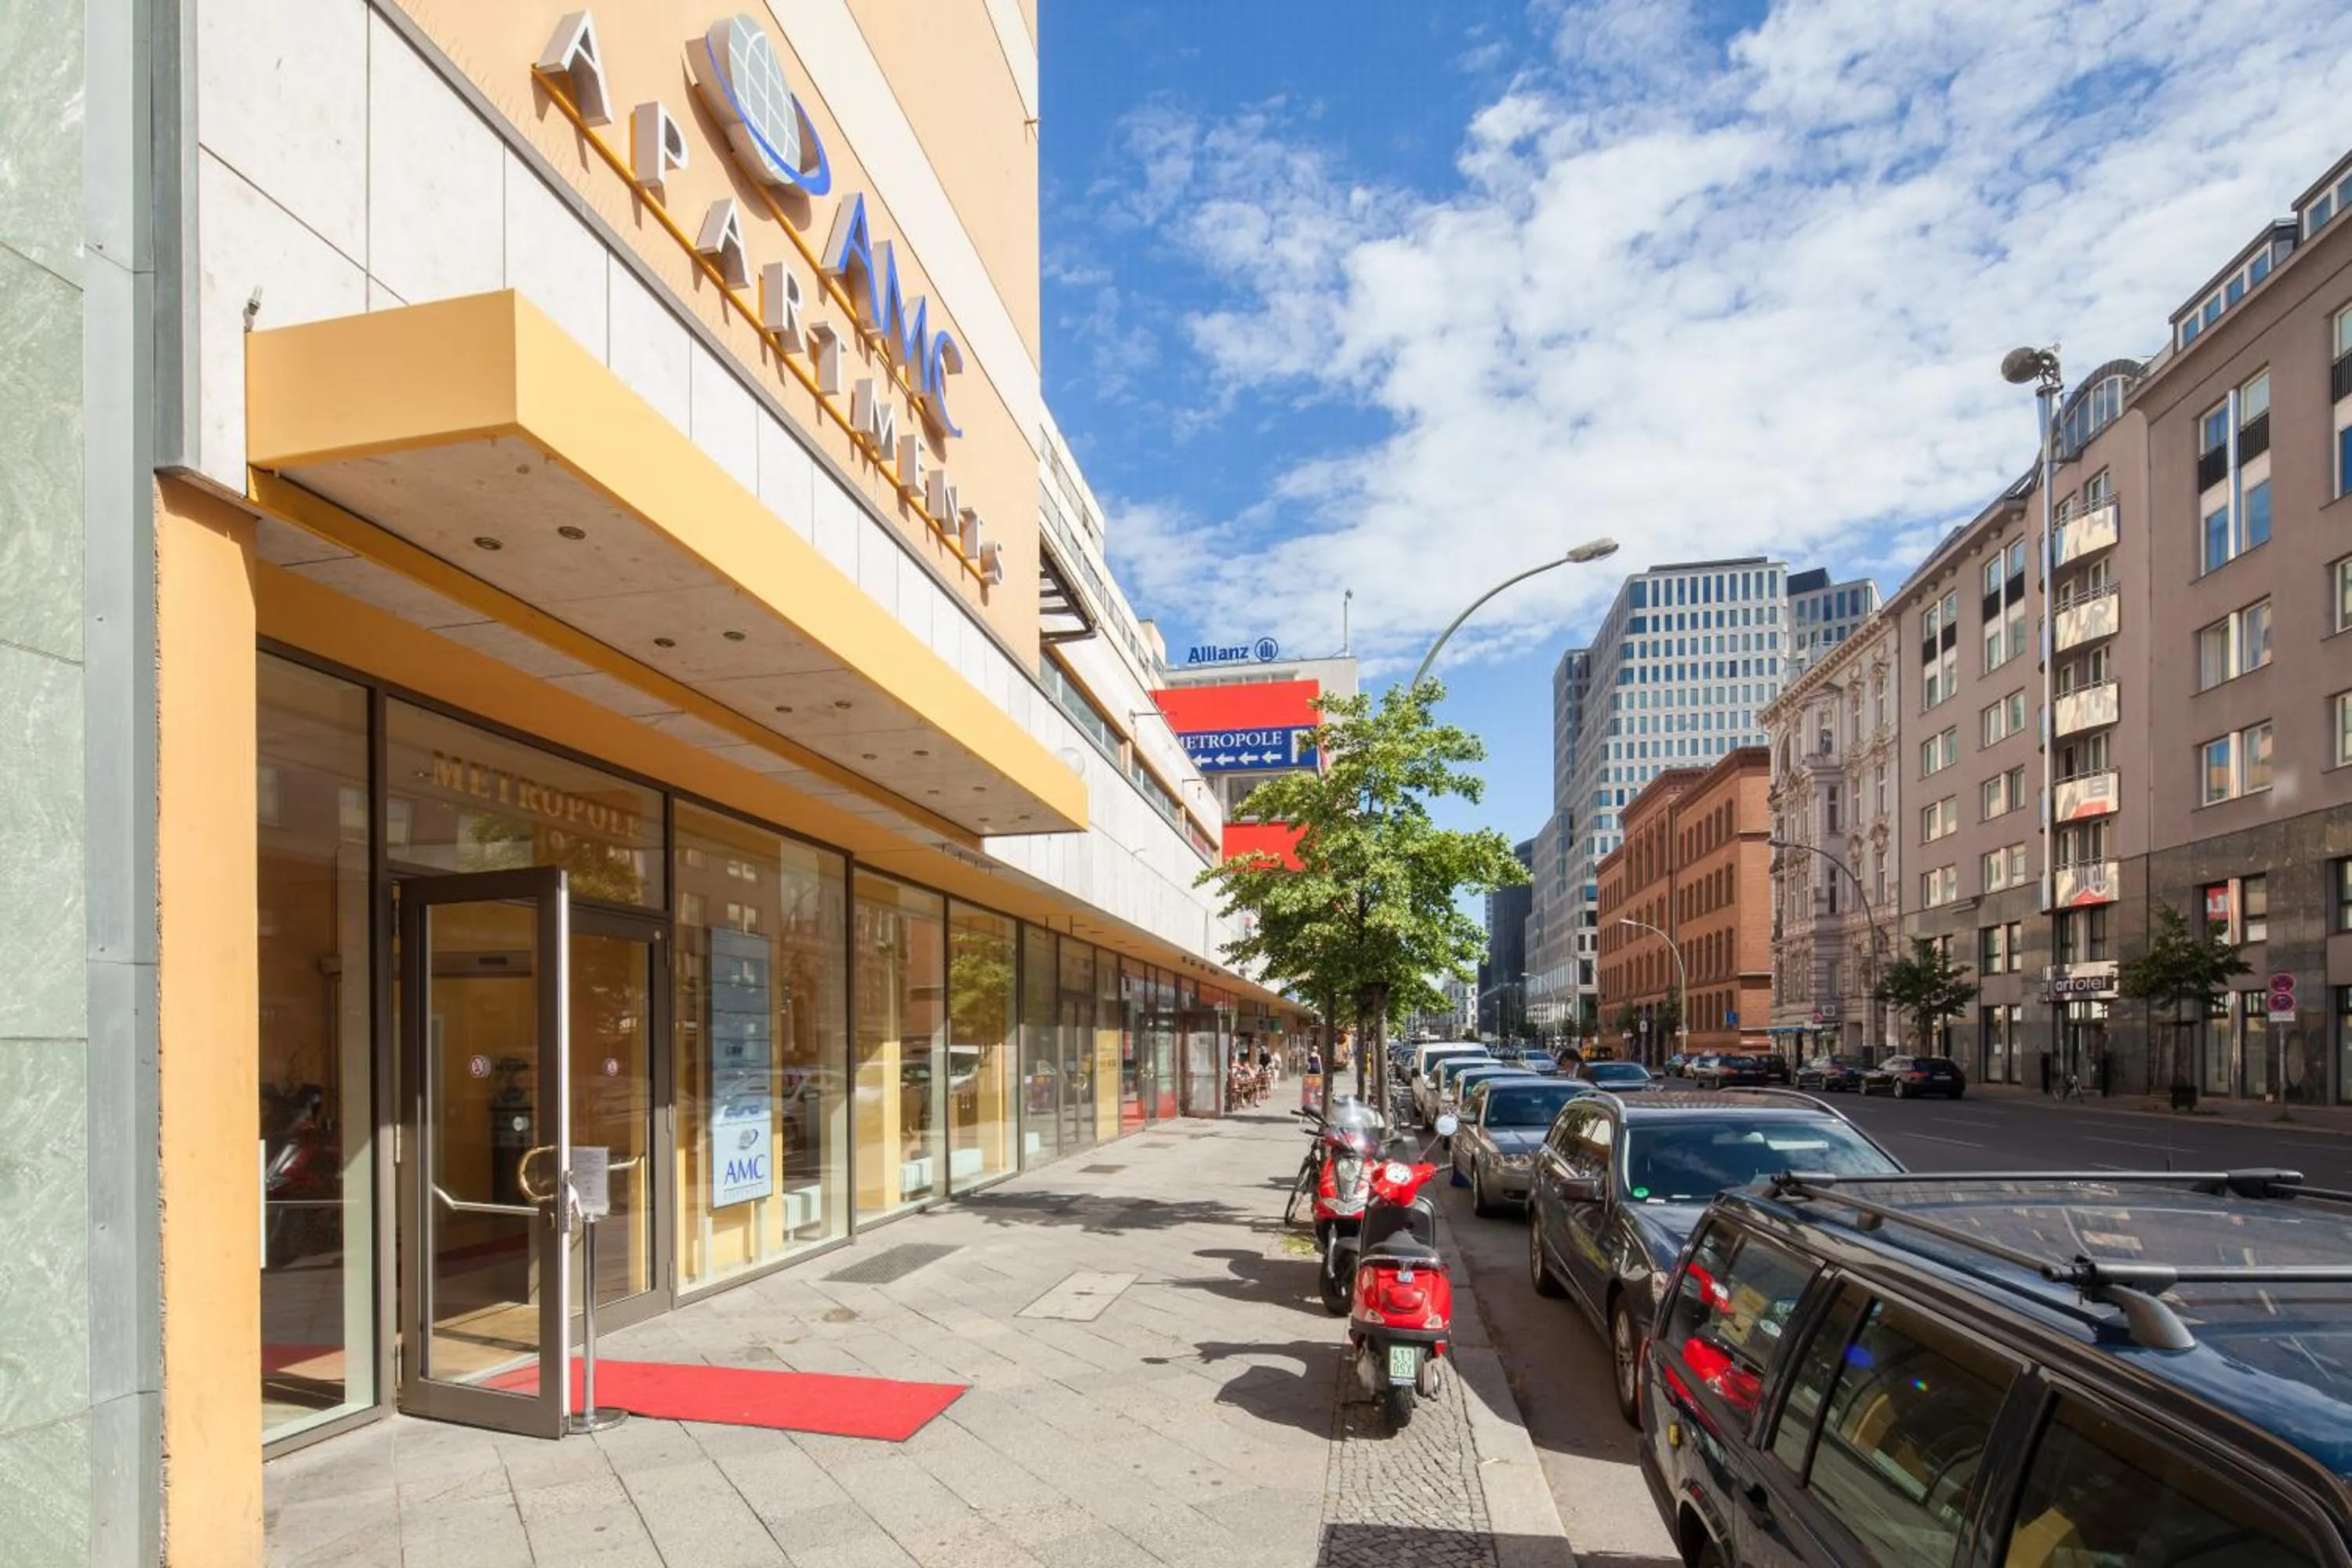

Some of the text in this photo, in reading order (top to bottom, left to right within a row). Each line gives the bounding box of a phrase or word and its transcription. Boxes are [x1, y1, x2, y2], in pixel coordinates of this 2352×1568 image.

[533, 9, 1002, 586] APARTMENTS
[822, 191, 964, 438] AMC
[1188, 645, 1249, 662] Allianz
[724, 1154, 765, 1185] AMC
